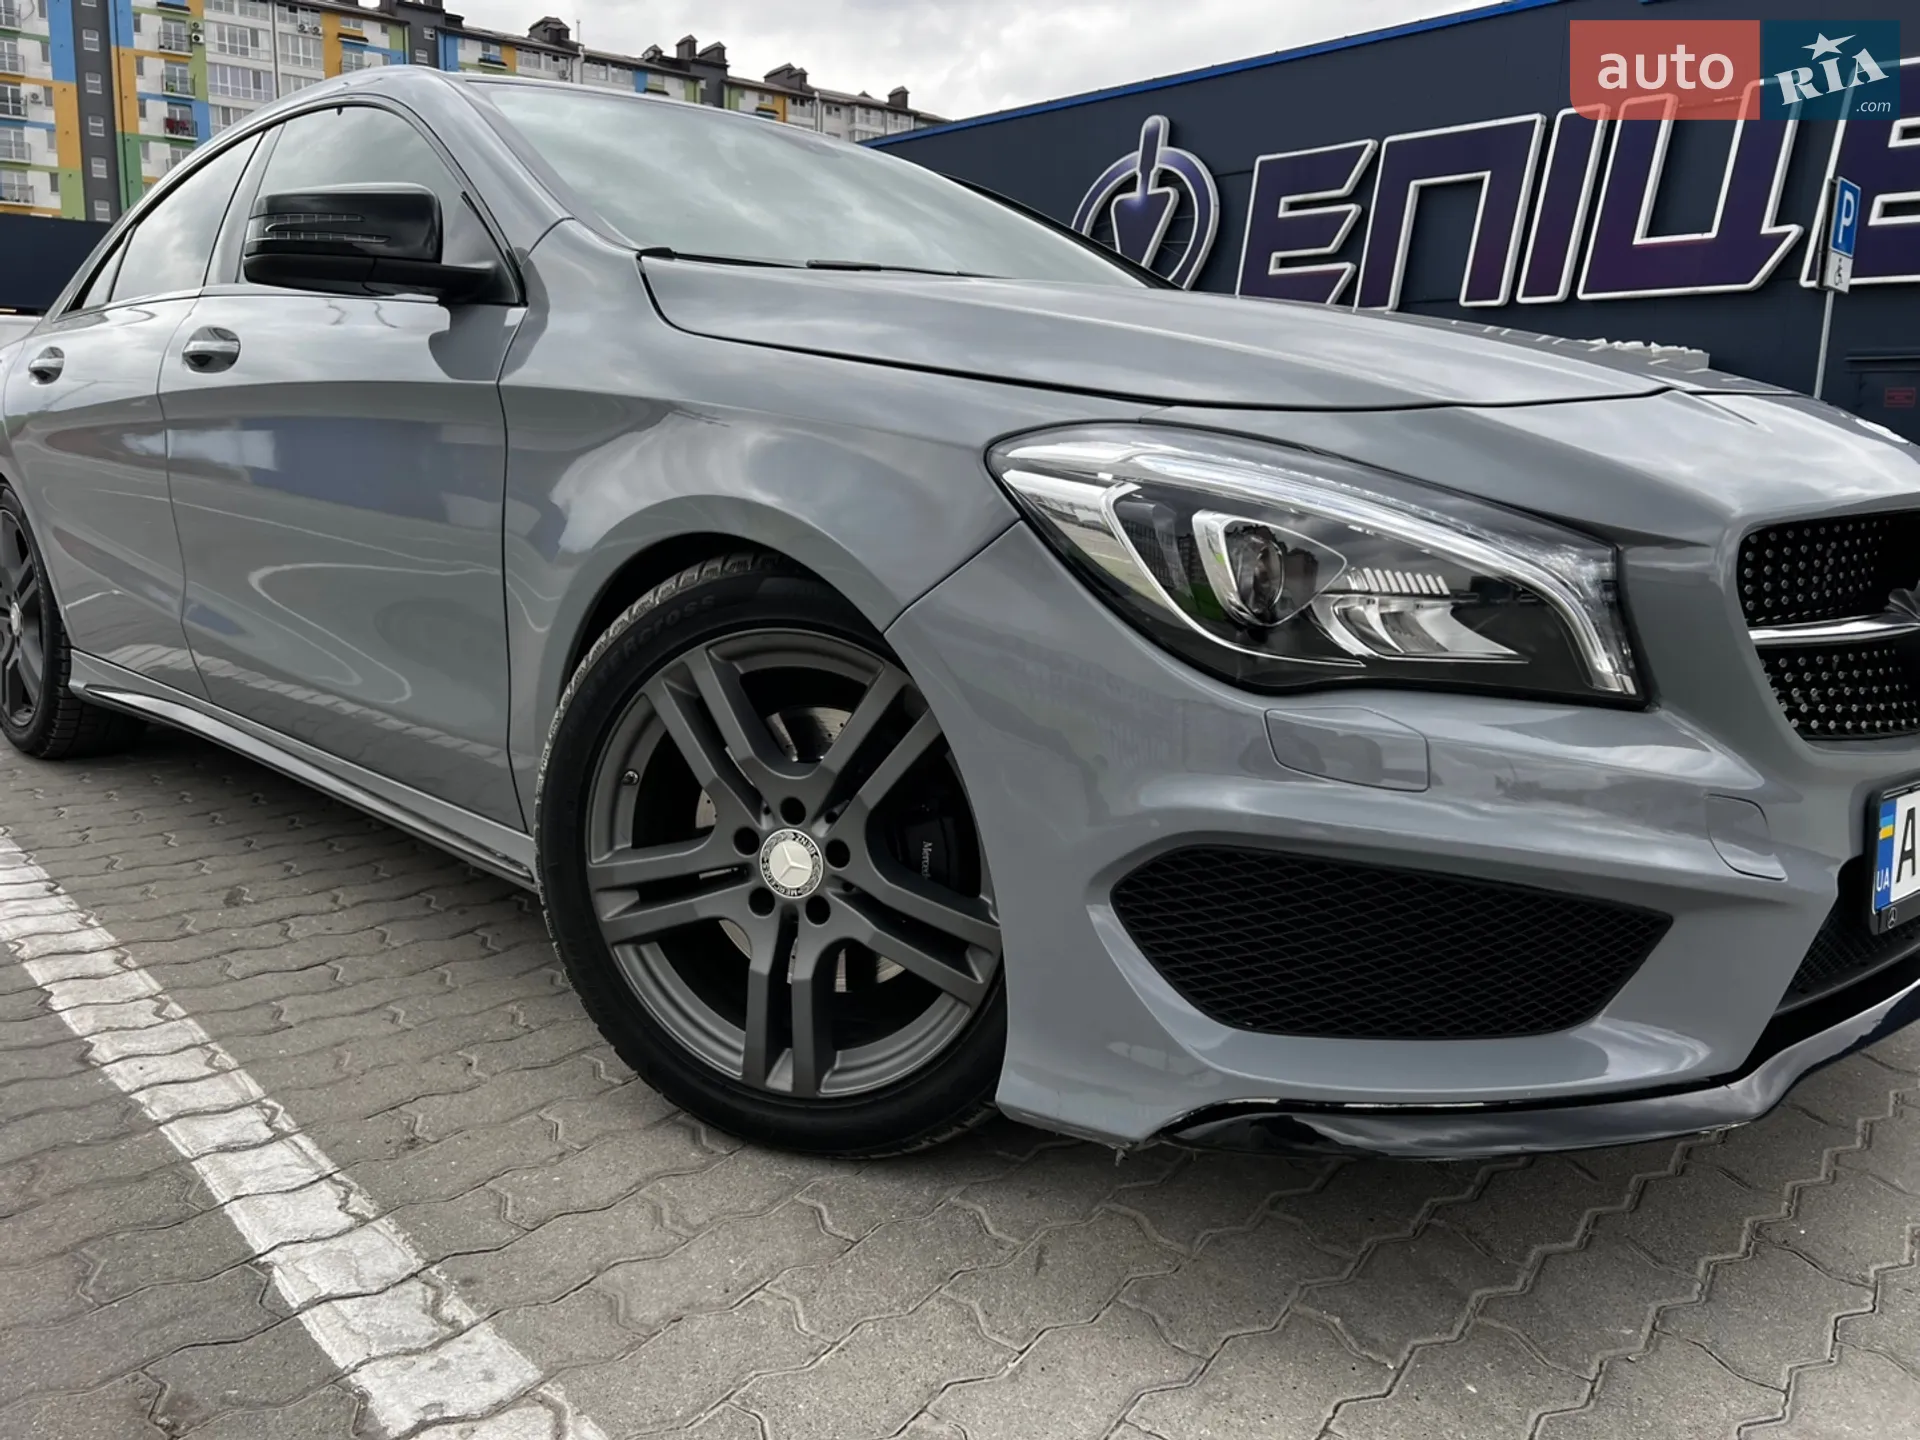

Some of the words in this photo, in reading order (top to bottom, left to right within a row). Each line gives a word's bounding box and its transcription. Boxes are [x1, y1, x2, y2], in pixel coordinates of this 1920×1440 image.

[1838, 190, 1855, 243] P
[1896, 806, 1916, 884] A
[1876, 867, 1889, 891] UA
